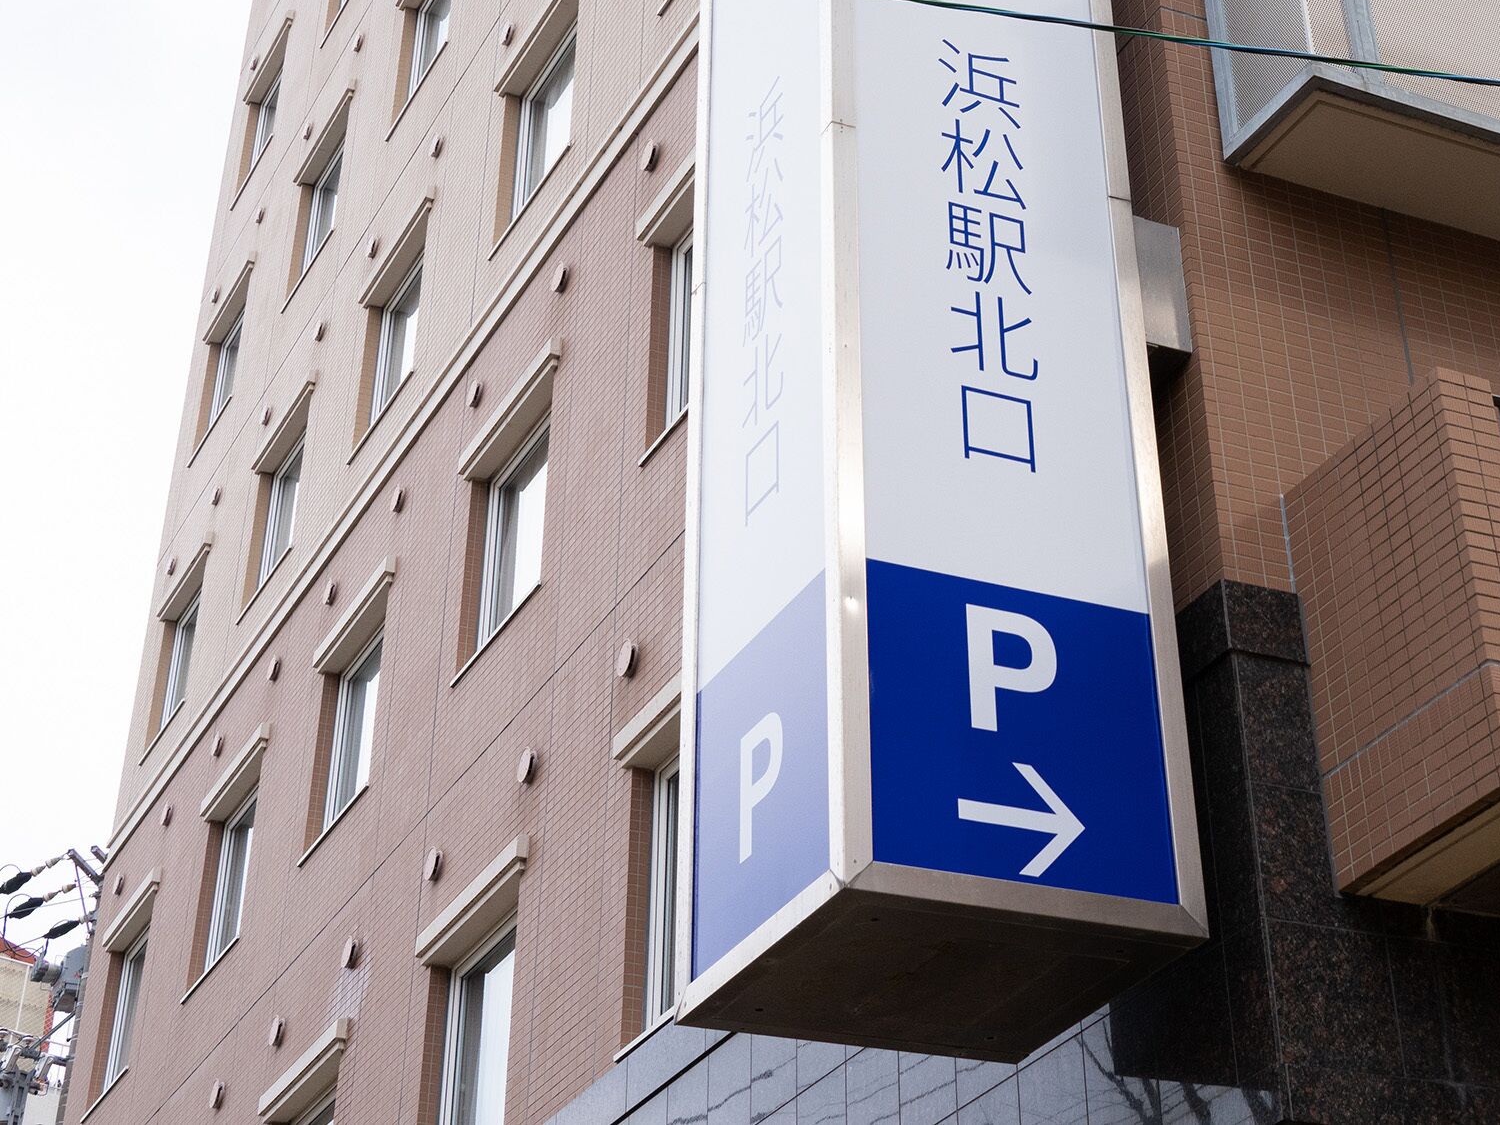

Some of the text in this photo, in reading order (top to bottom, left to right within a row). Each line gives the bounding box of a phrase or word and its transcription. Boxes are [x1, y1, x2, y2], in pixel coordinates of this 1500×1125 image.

[743, 75, 783, 527] 浜松駅北口
[938, 39, 1039, 473] 浜松駅北口
[739, 711, 783, 864] P
[965, 603, 1057, 732] P
